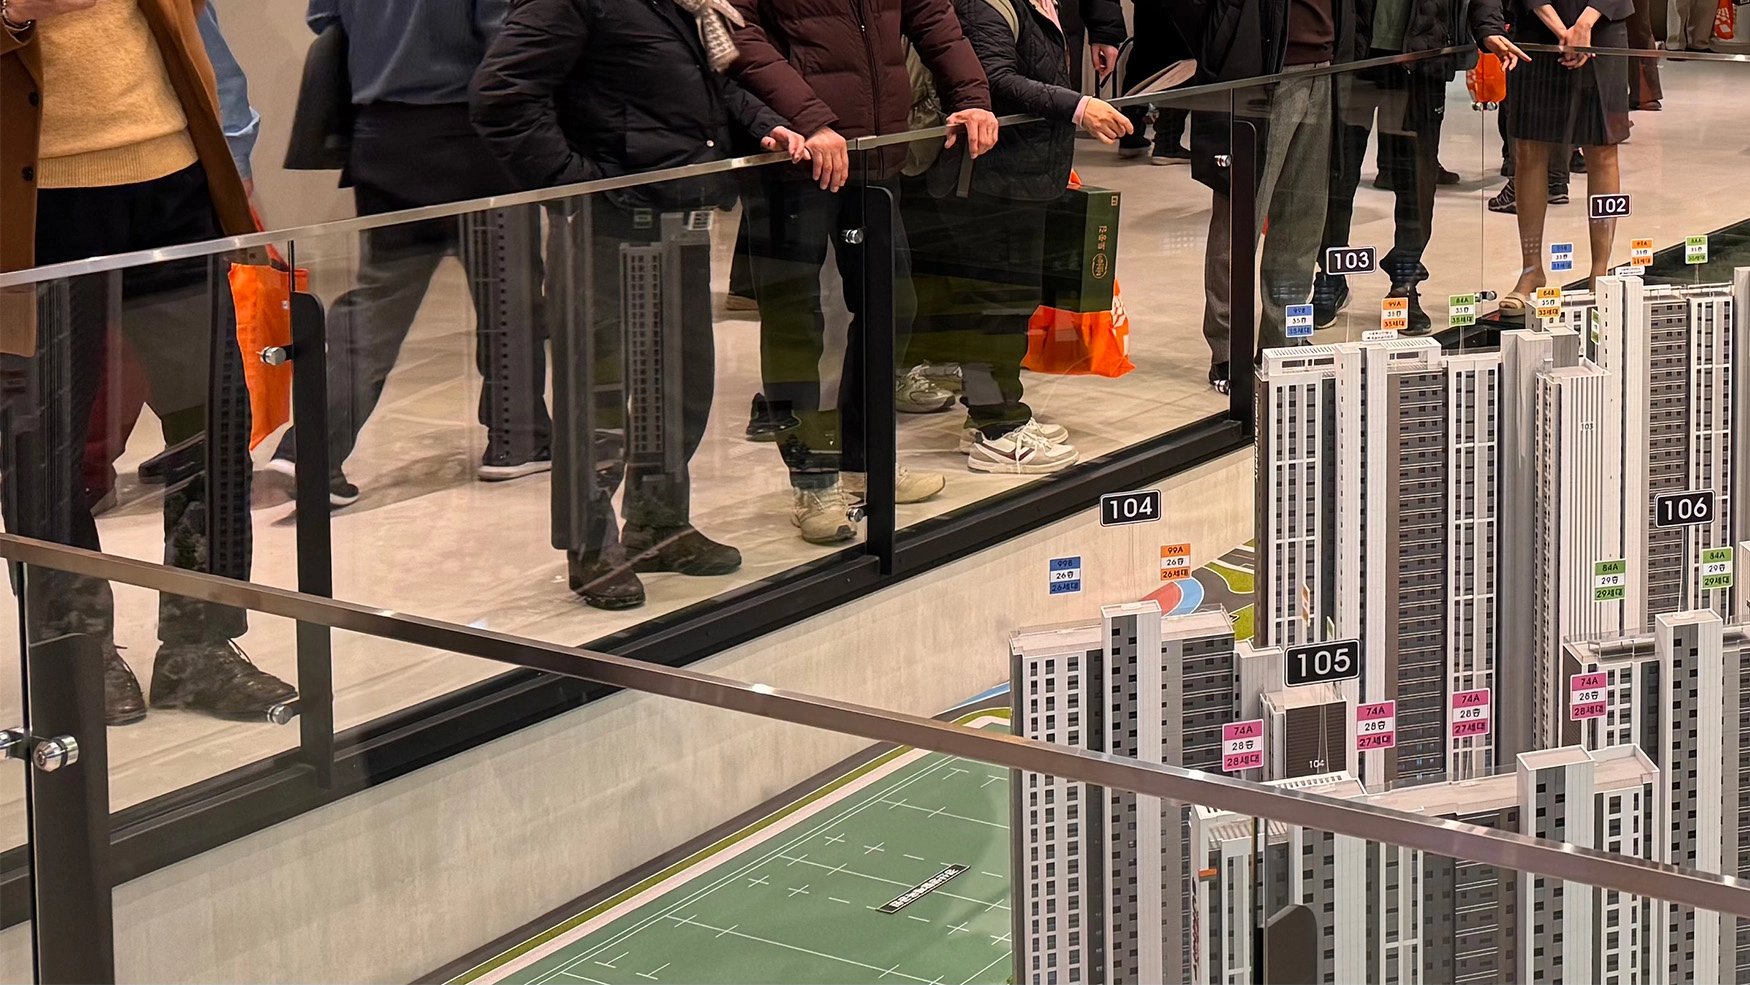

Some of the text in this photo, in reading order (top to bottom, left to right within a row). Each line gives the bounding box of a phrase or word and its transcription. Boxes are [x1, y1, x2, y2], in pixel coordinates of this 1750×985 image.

[1596, 197, 1626, 214] 102
[1333, 252, 1370, 270] 103
[1109, 497, 1153, 519] 104
[1663, 497, 1707, 520] 106
[1167, 546, 1183, 554] 99A
[1057, 559, 1073, 567] 99B
[1602, 563, 1619, 571] 84A
[1162, 569, 1189, 578] 26세대
[1704, 575, 1730, 585] 29세대
[1051, 581, 1079, 593] 26세대
[1596, 587, 1623, 598] 29세대
[1295, 648, 1352, 677] 105
[1581, 678, 1599, 687] 74A
[1461, 694, 1480, 704] 74A
[1366, 707, 1385, 715] 74A
[1574, 705, 1604, 716] 28세대
[1234, 727, 1253, 735] 74A
[1454, 722, 1486, 734] 27세대
[1359, 735, 1392, 747] 27세대
[1227, 754, 1260, 766] 28세대
